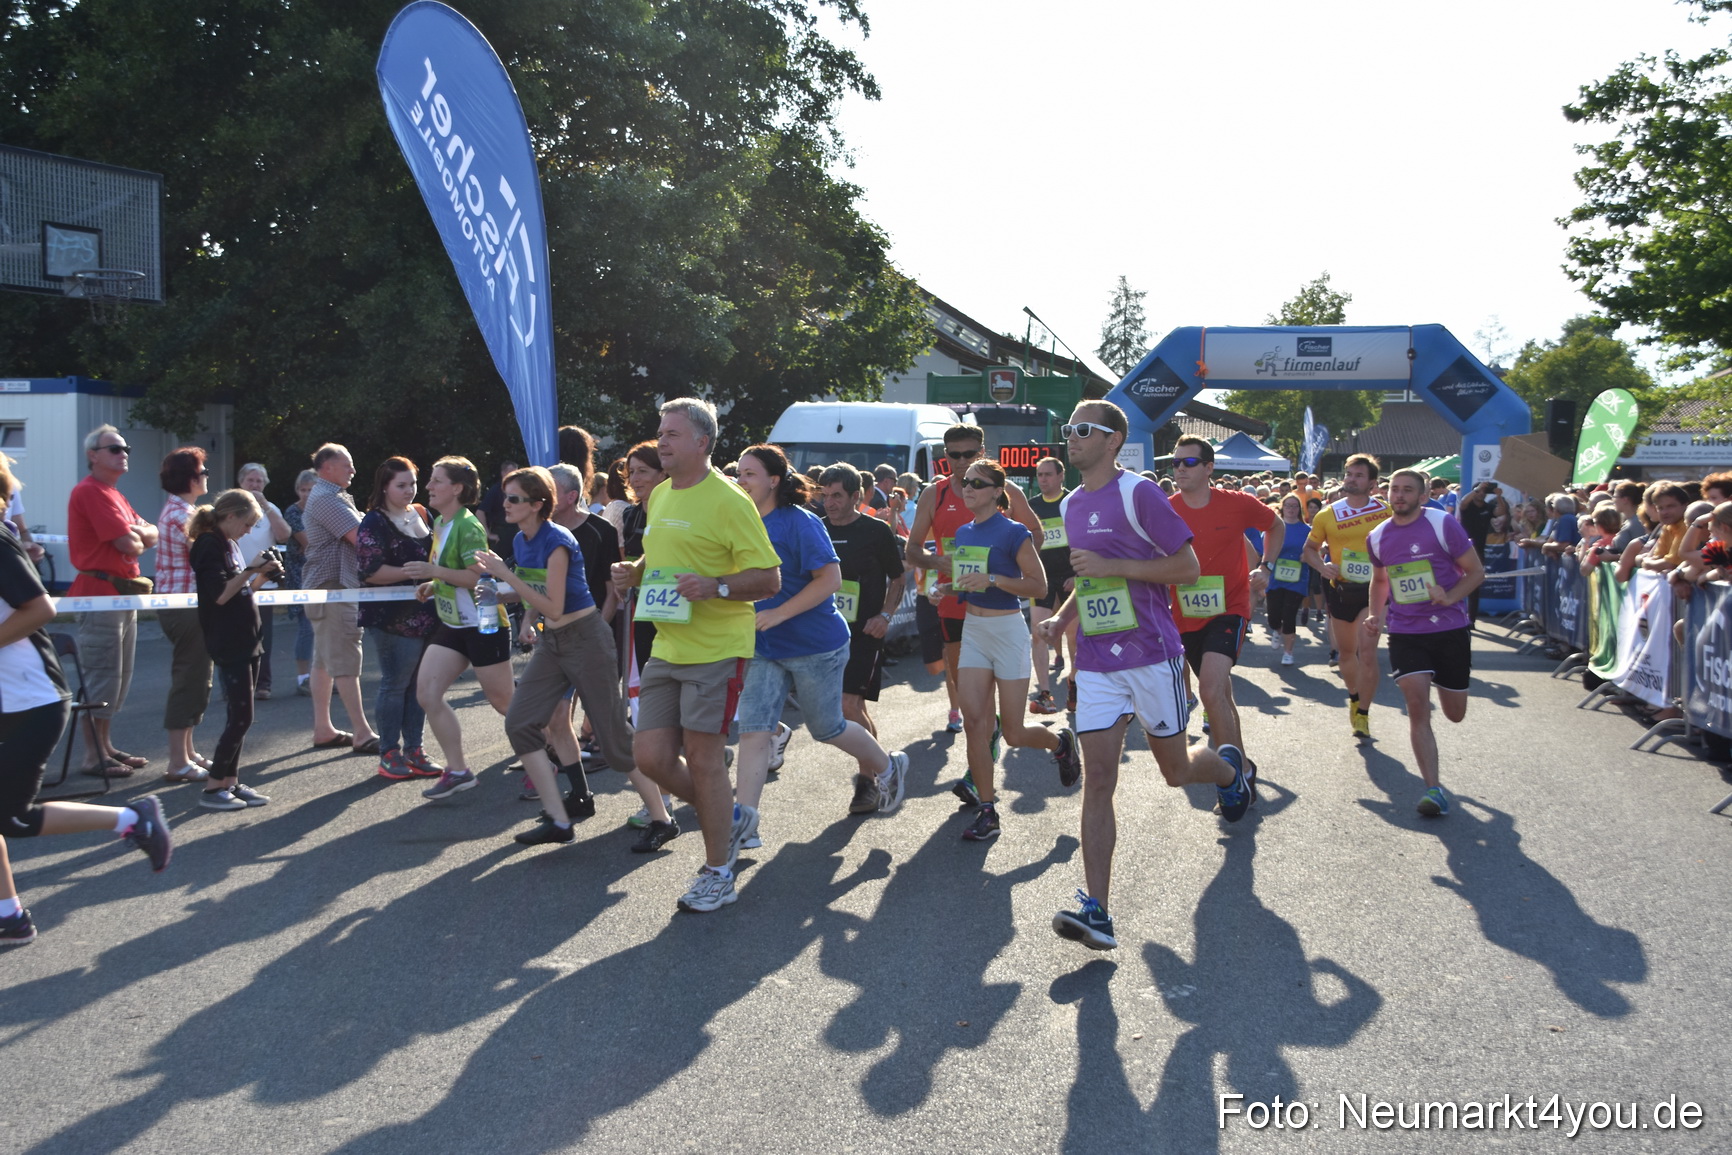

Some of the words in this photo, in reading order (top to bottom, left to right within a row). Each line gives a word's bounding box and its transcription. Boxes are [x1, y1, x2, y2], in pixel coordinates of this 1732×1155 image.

[1284, 357, 1361, 371] firmenlauf
[1139, 385, 1180, 393] Fischer
[1603, 423, 1627, 450] AOK
[1645, 437, 1677, 446] Jura
[1577, 442, 1606, 471] AOK
[1337, 519, 1362, 530] MAX
[1364, 512, 1392, 523] BÖGL
[1280, 567, 1296, 577] 777
[1347, 563, 1370, 576] 898
[1400, 577, 1425, 593] 501
[645, 588, 680, 607] 642
[836, 596, 852, 611] 51
[1182, 593, 1219, 608] 1491
[1087, 596, 1121, 618] 502
